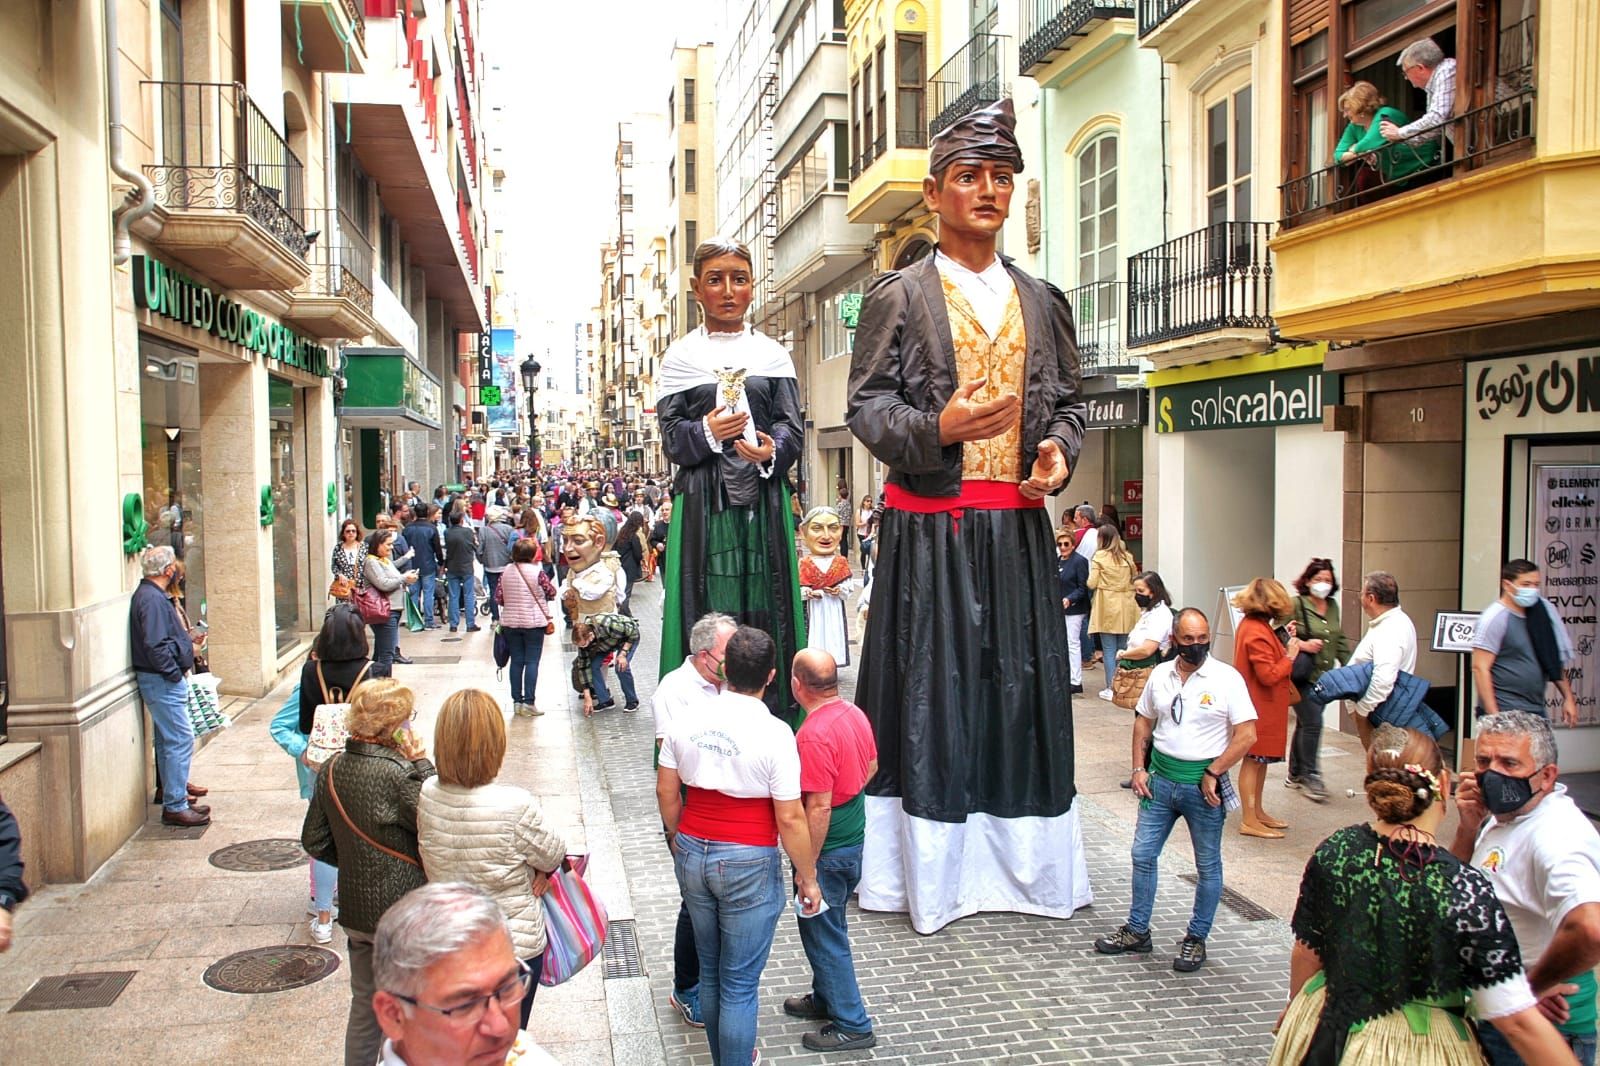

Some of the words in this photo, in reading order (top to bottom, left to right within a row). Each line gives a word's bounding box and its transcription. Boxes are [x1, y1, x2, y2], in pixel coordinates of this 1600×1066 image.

[144, 255, 213, 331] UNITED
[216, 293, 268, 354] COLORS
[268, 322, 284, 361] OF
[284, 327, 329, 377] BENETTON
[1190, 374, 1322, 426] solscabell
[1088, 399, 1124, 421] Festa
[1409, 407, 1425, 423] 10
[1559, 478, 1600, 488] ELEMENT
[1551, 495, 1596, 508] ellesse
[1547, 595, 1597, 608] RVCA
